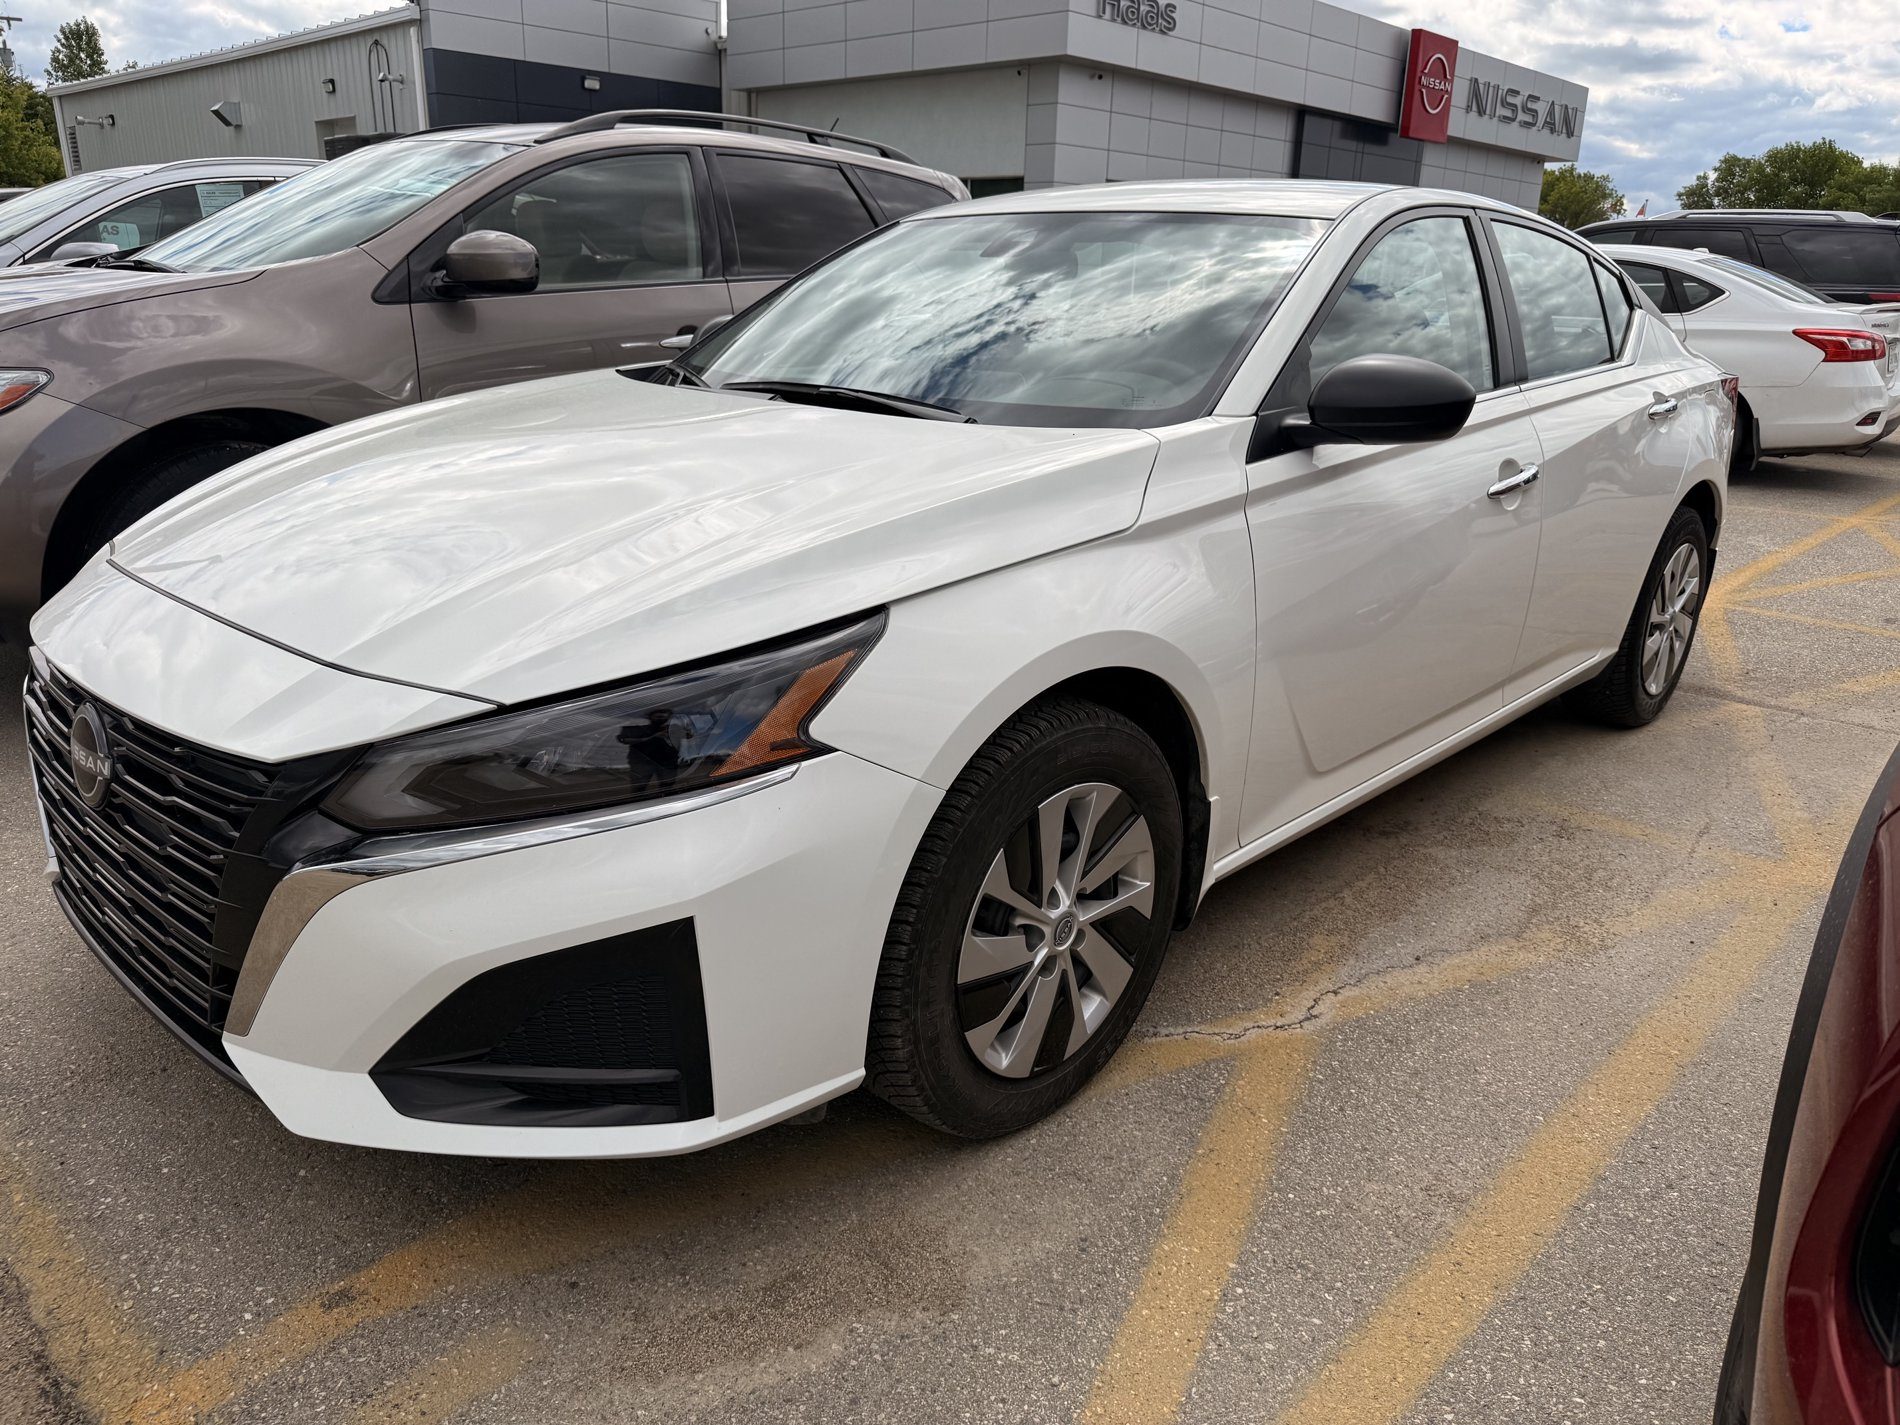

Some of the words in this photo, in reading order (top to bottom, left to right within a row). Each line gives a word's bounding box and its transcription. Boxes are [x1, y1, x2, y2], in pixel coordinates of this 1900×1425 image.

[1420, 75, 1452, 93] NISSAN
[1466, 77, 1578, 138] NISSAN
[73, 743, 108, 776] SSAN
